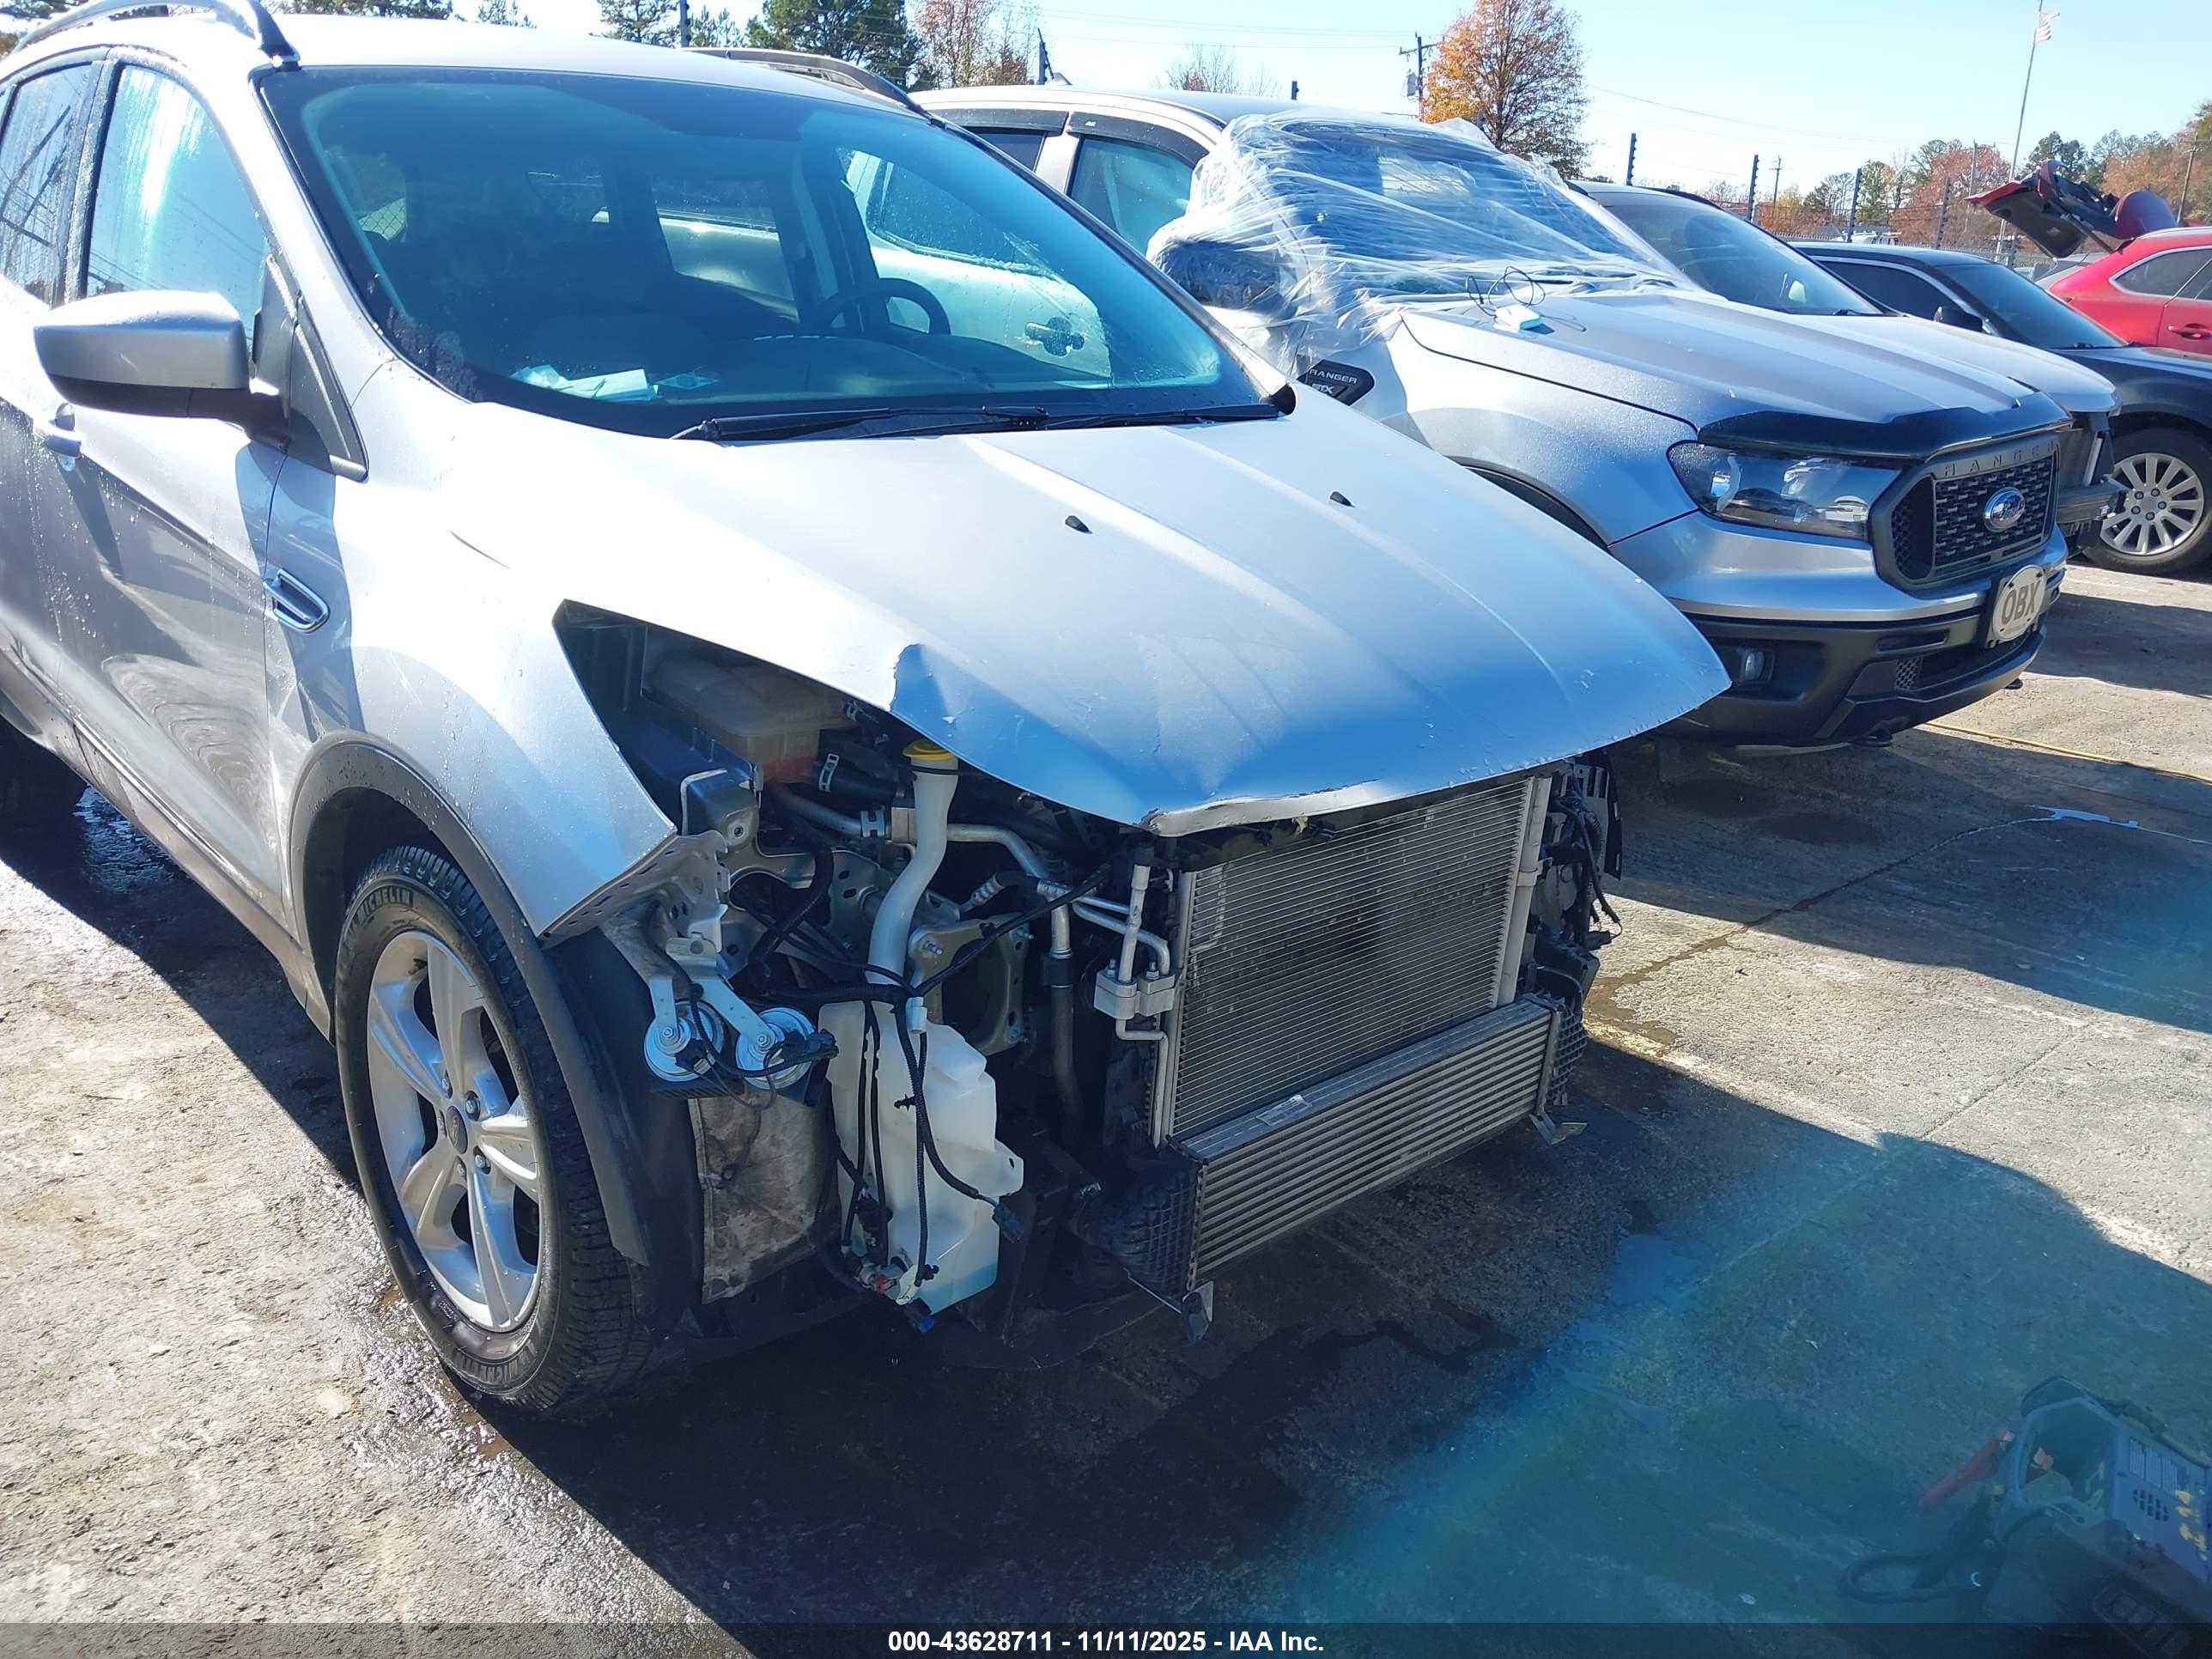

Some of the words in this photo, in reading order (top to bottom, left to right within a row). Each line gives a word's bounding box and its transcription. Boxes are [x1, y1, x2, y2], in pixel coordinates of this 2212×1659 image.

[1309, 369, 1358, 384] RANGER
[2001, 580, 2040, 625] OBX
[355, 887, 411, 923] MICHELIN
